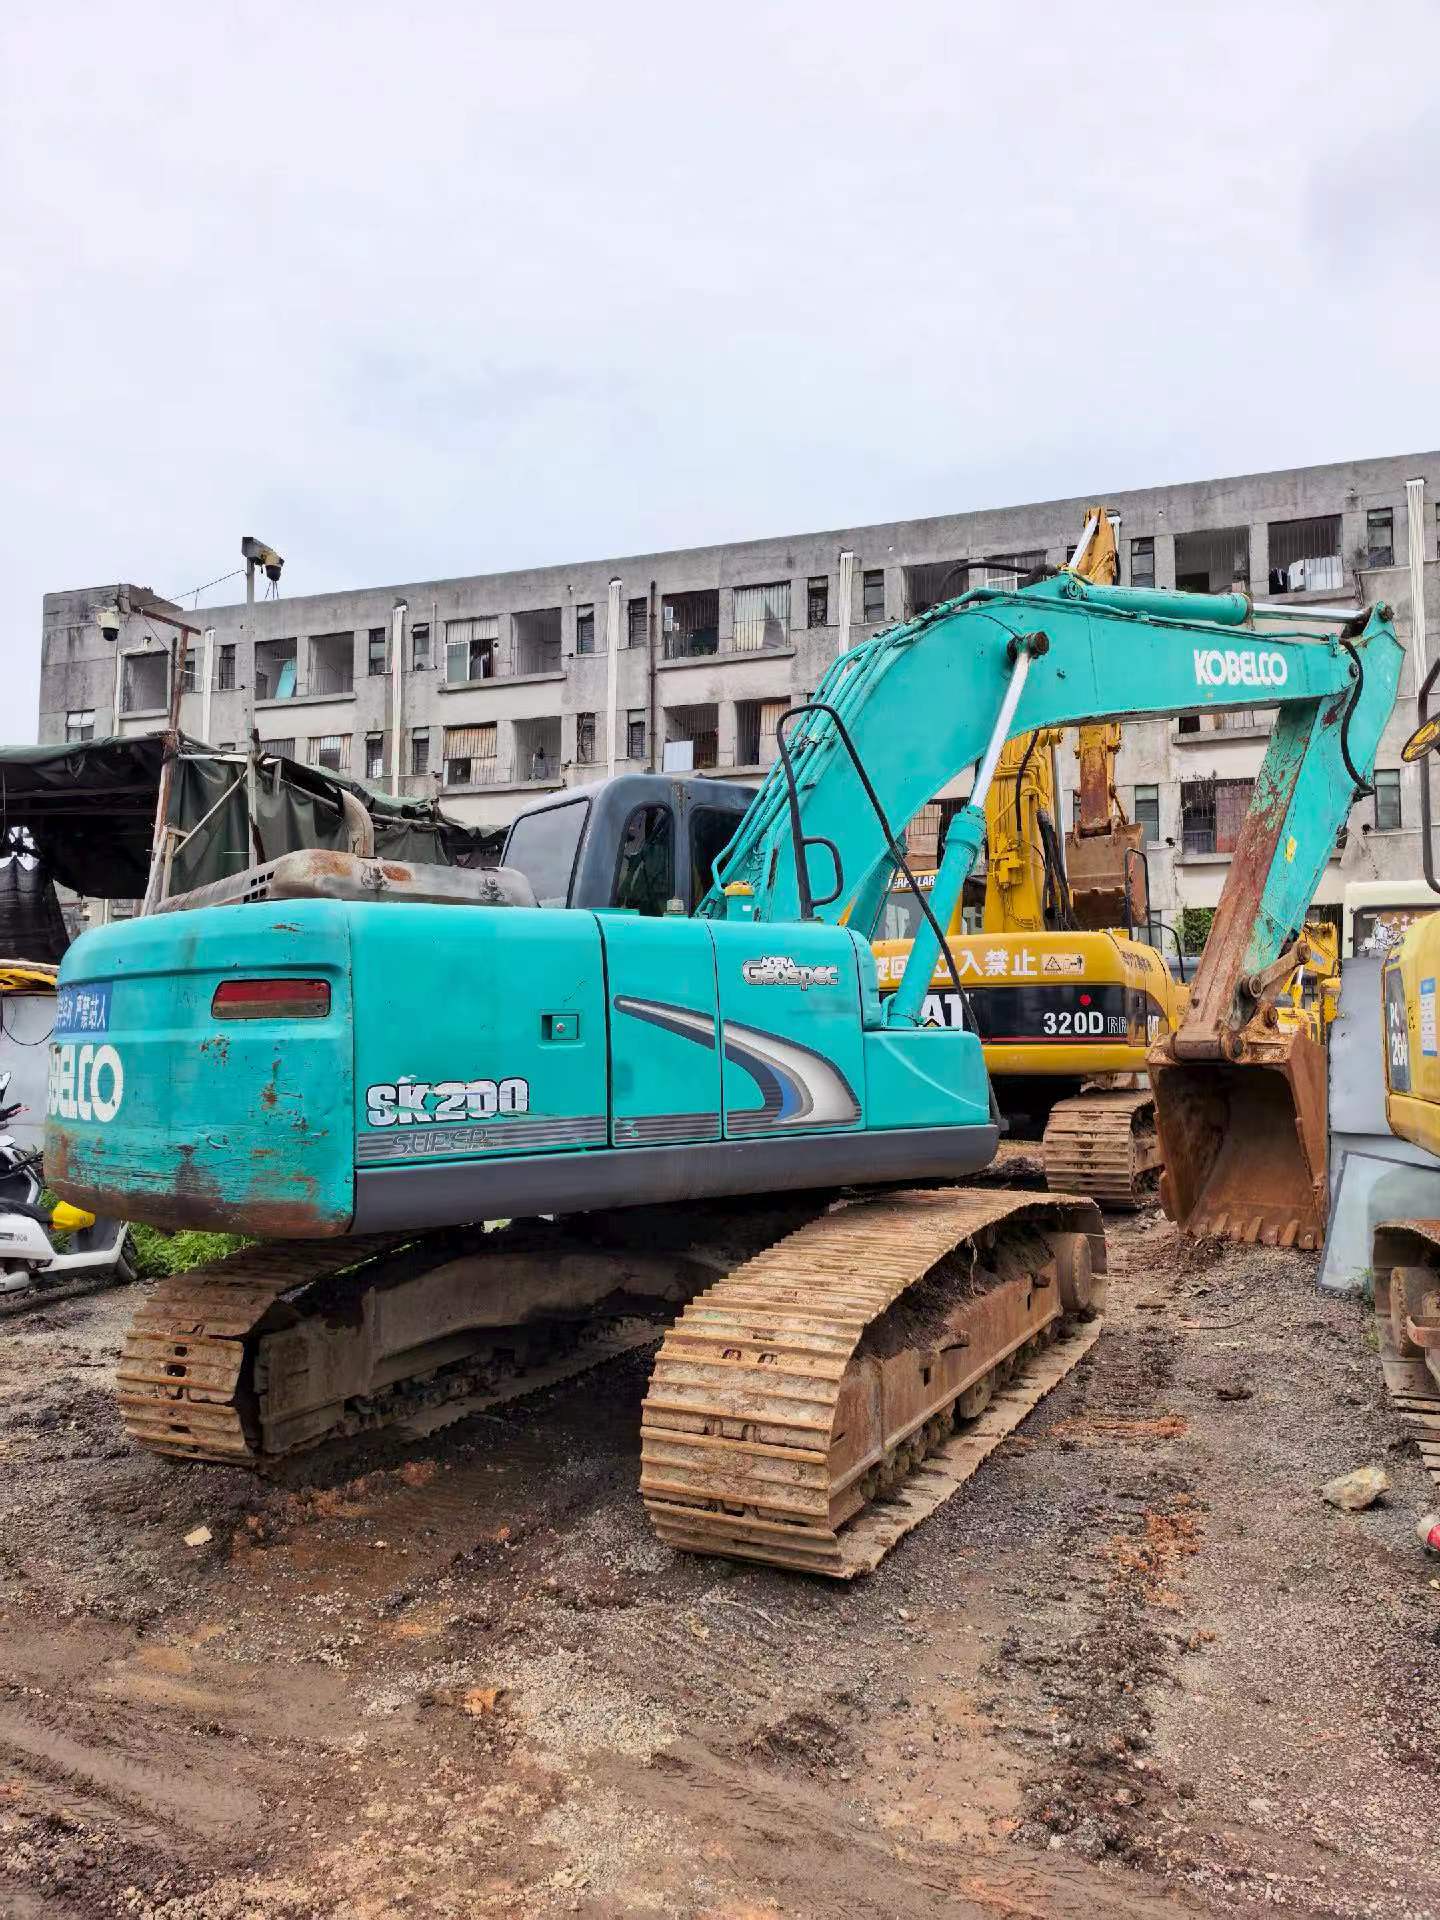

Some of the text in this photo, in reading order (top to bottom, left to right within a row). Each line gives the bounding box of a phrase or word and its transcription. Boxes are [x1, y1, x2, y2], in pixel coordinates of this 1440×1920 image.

[1193, 648, 1288, 686] KOBELCO
[920, 993, 970, 1031] AT
[1043, 1011, 1104, 1035] 320D
[367, 1077, 529, 1127] SK200
